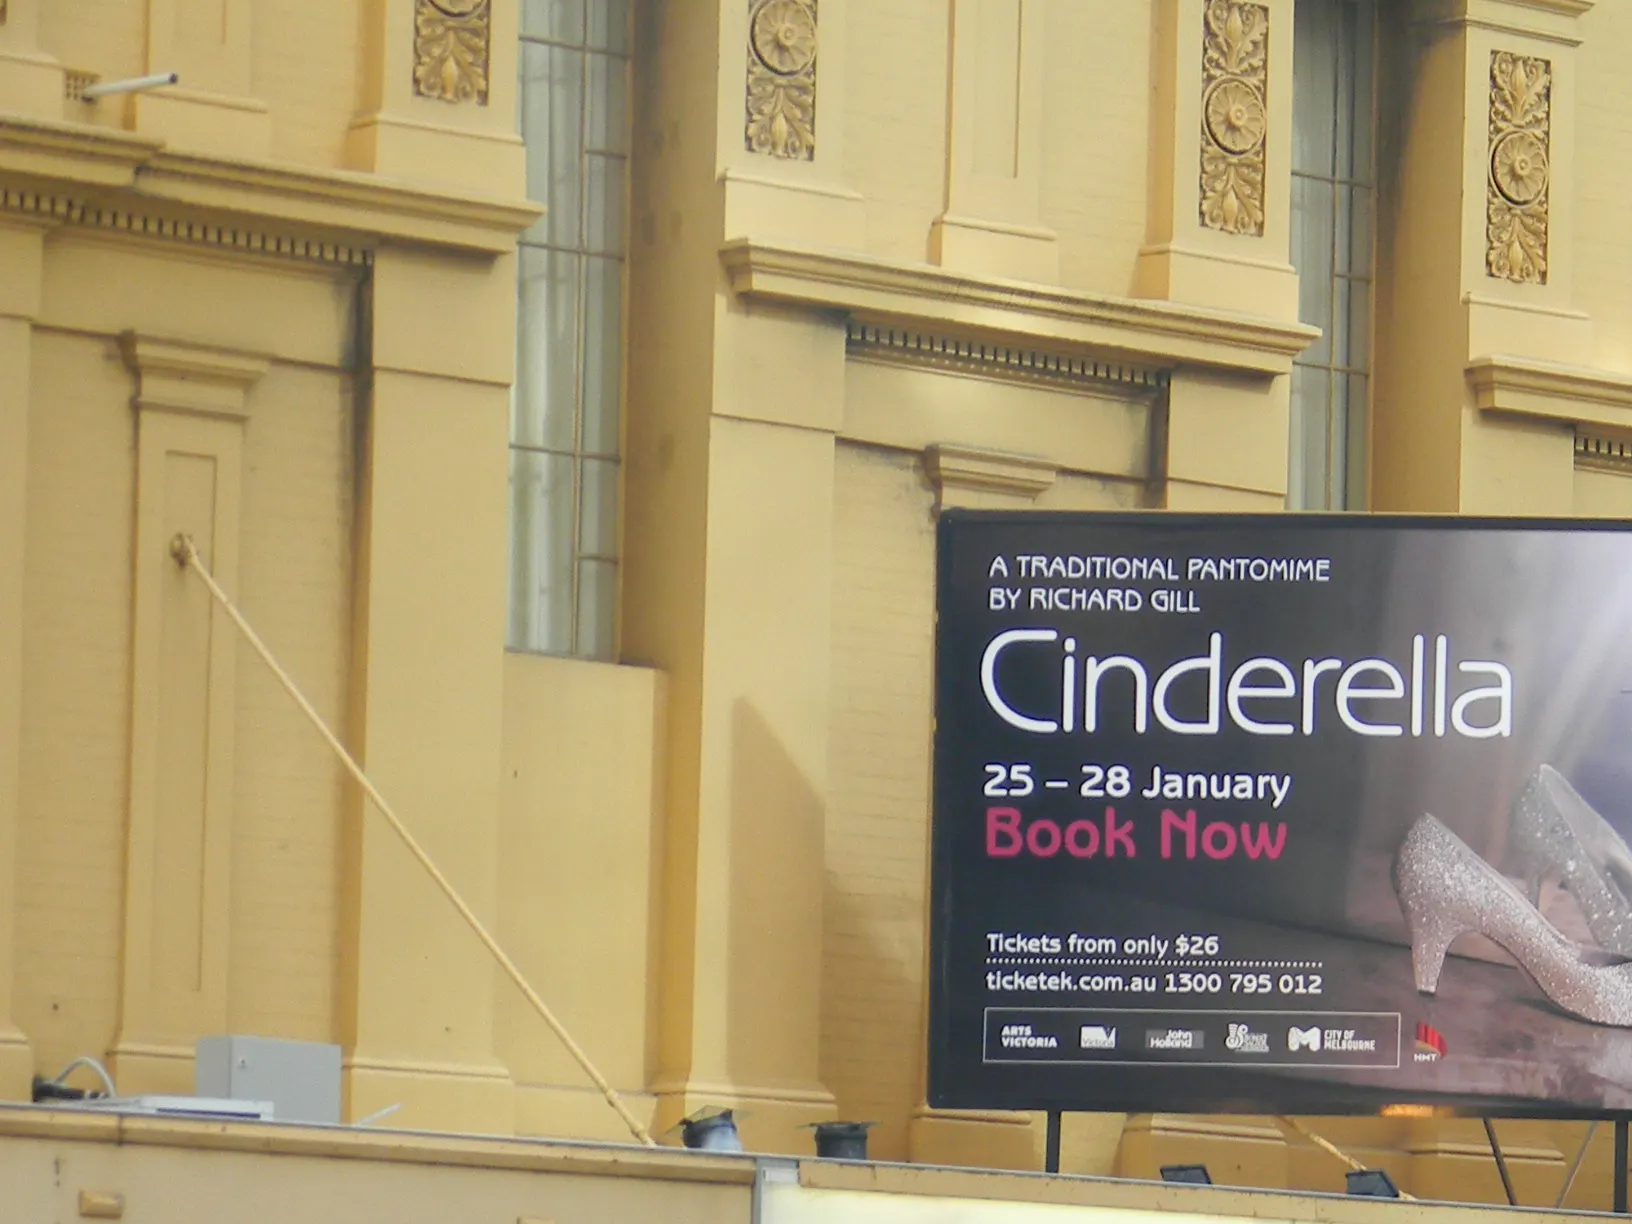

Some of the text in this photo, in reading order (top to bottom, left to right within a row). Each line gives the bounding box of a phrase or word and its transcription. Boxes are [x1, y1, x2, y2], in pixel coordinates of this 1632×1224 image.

[989, 555, 1331, 581] A TRADITIONAL PANTOMIME
[989, 588, 1200, 612] BY RICHARD GILL
[981, 629, 1512, 738] Cinderella
[983, 764, 1035, 797] 25
[1080, 765, 1131, 798] 28
[1142, 766, 1291, 809] January
[985, 807, 1287, 859] Book Now
[987, 933, 1219, 959] Tickets from only $26
[986, 971, 1322, 994] ticketek.com.au 1300 795 012
[1001, 1025, 1032, 1036] ARTS
[1166, 1029, 1193, 1040] John
[1324, 1030, 1355, 1040] CITY OF
[1001, 1037, 1059, 1048] VICTORIA
[1324, 1040, 1376, 1050] MELBOURNE
[1414, 1053, 1437, 1062] HMT
